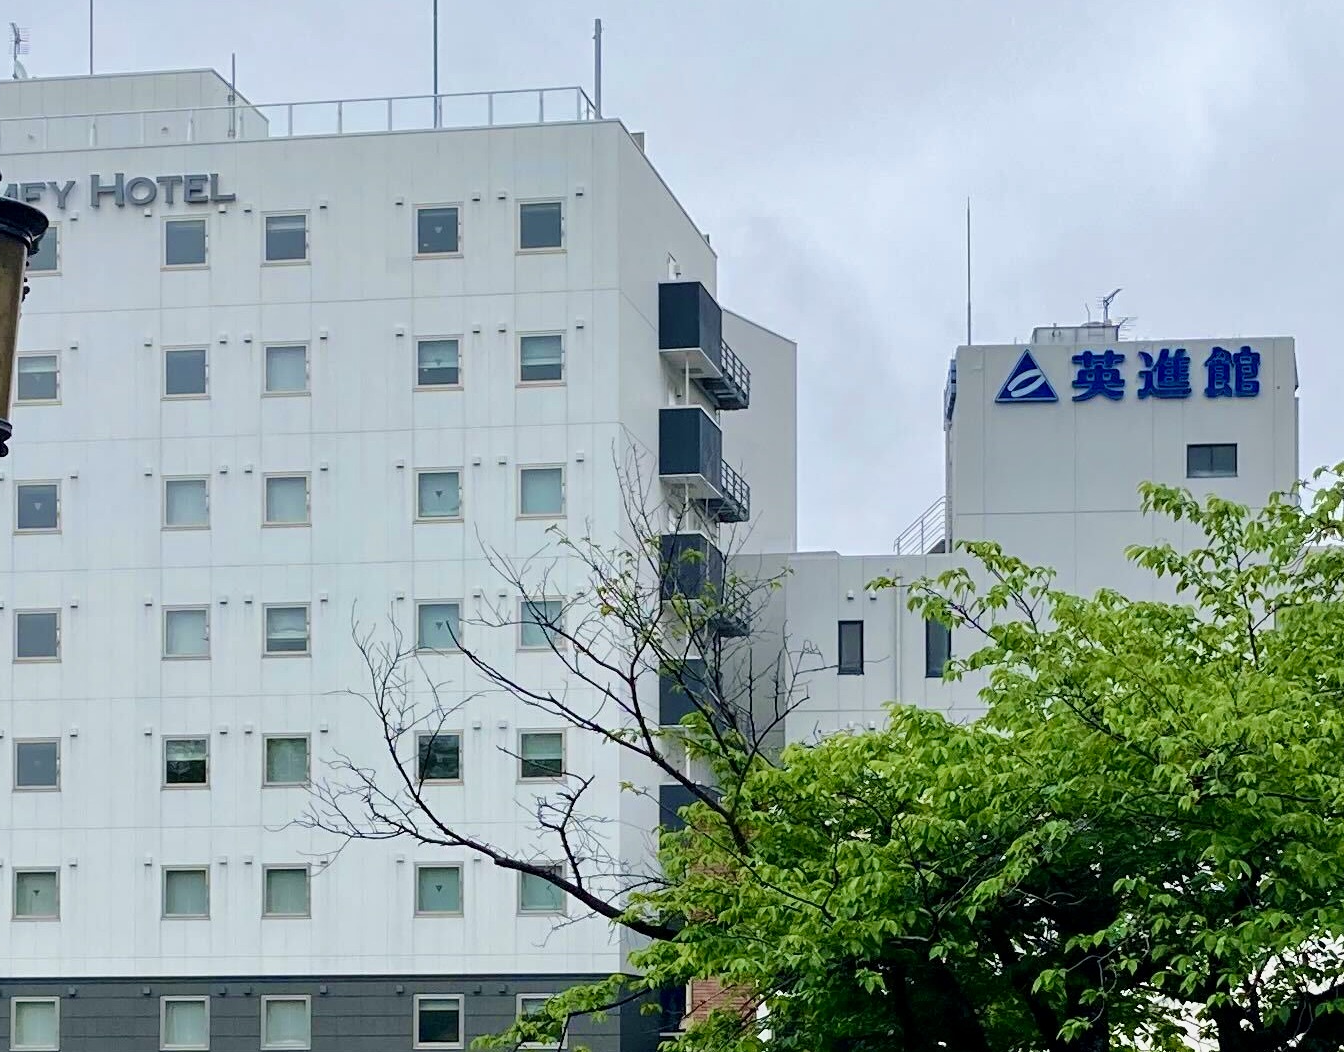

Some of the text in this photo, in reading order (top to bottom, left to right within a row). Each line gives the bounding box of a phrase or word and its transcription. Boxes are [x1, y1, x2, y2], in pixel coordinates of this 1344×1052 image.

[90, 172, 236, 207] HOTEL
[1071, 346, 1260, 402] 英進館
